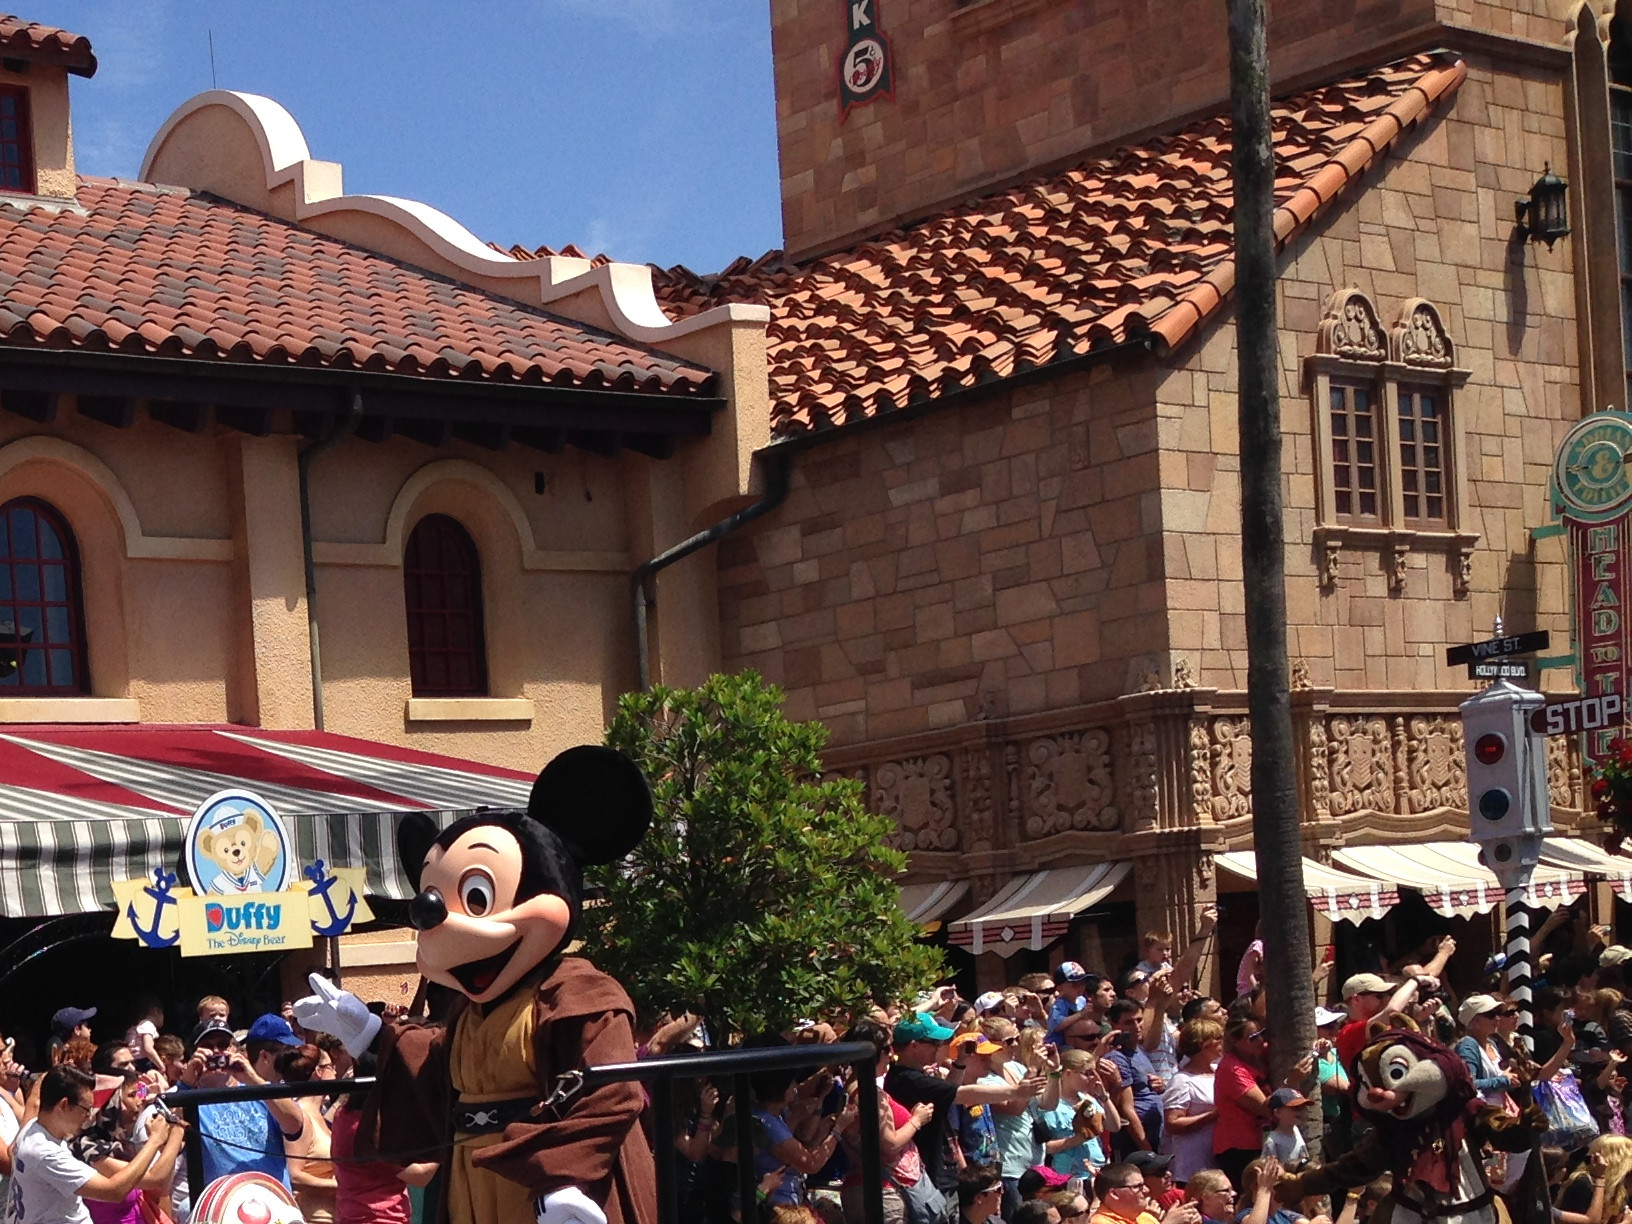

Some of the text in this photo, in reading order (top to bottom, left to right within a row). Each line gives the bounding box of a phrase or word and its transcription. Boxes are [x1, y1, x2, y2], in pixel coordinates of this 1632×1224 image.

[1588, 525, 1619, 637] HEAD
[1471, 641, 1500, 657] VINE
[1476, 665, 1510, 677] HOLLYWOD
[1546, 695, 1621, 735] STOP
[1594, 672, 1619, 755] TE
[205, 902, 281, 933] Duffy
[208, 932, 286, 950] The Disney Bear
